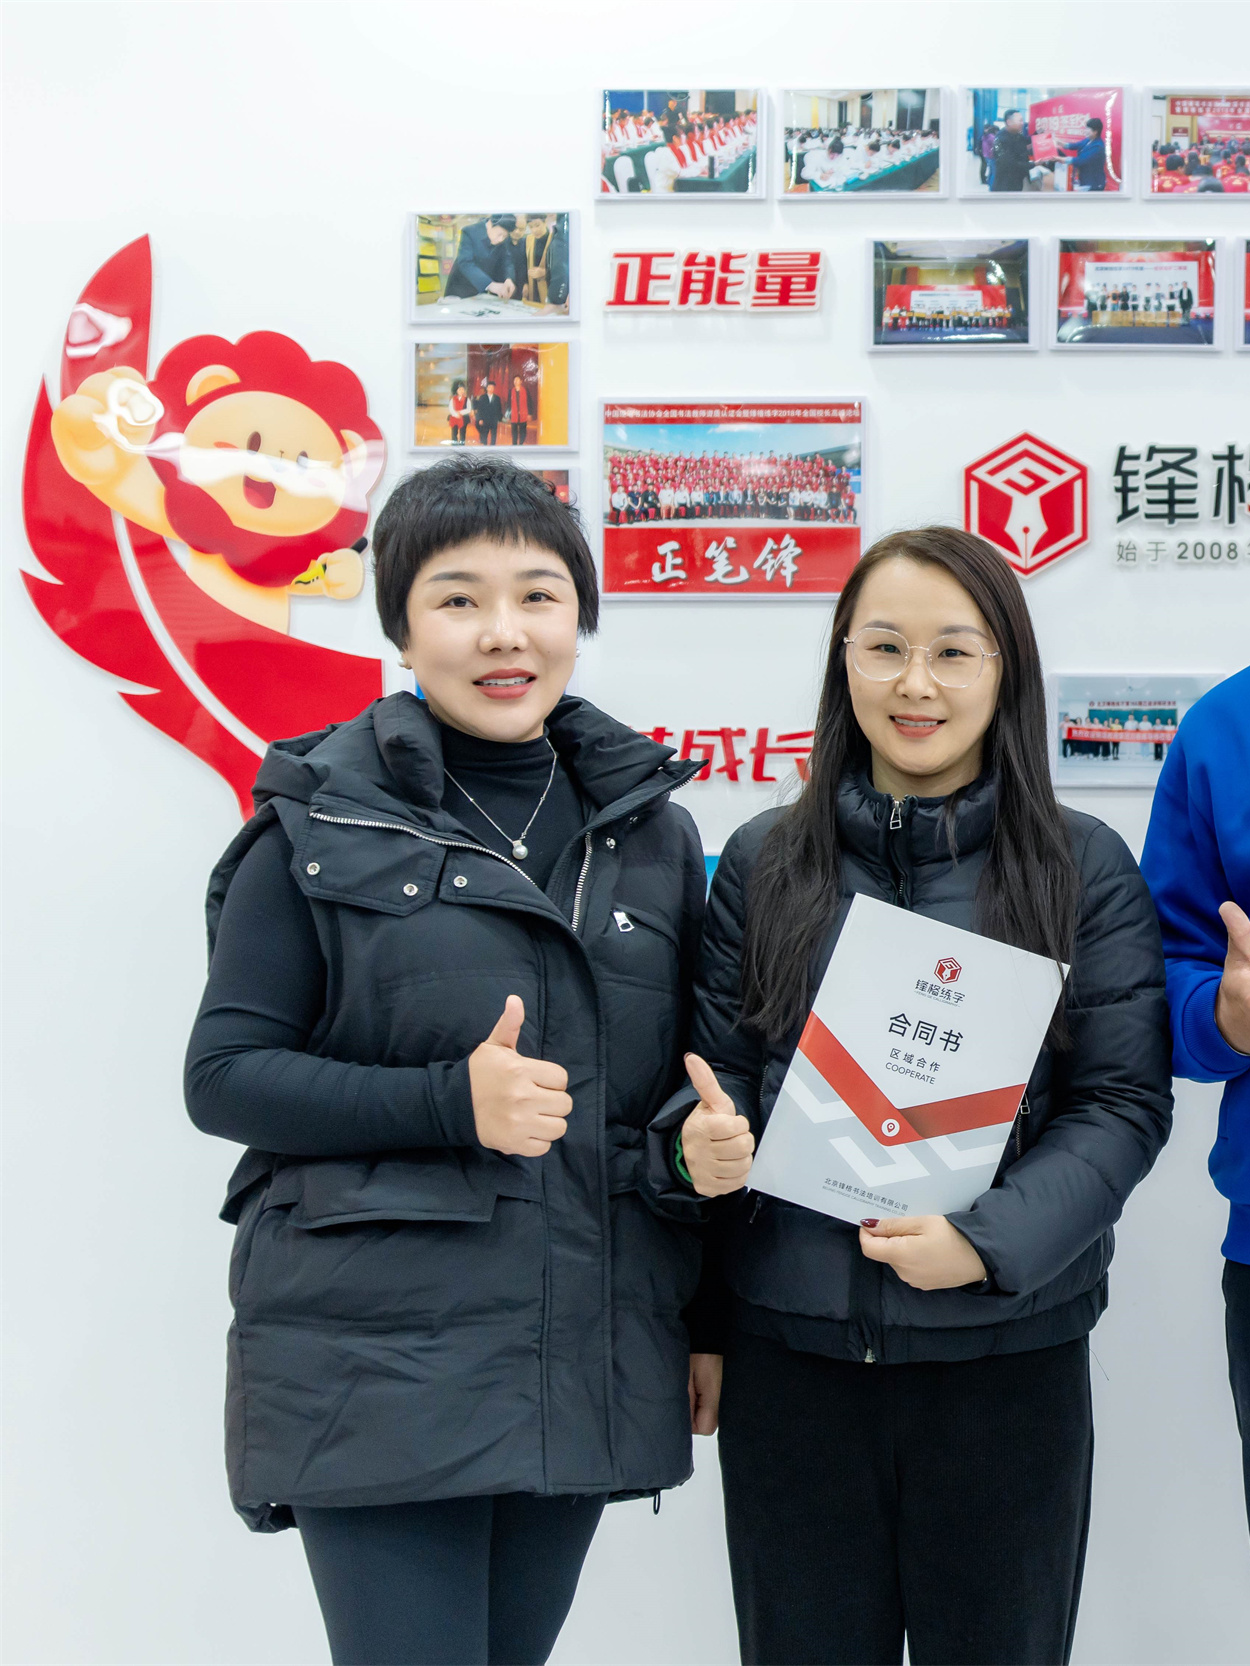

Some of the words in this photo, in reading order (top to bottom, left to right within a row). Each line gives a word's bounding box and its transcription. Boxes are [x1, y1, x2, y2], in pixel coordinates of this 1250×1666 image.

[605, 251, 823, 308] 正能量
[650, 533, 804, 589] 正笔锋
[636, 726, 815, 783] 成长
[915, 979, 966, 1004] 锋格练字
[888, 1013, 964, 1053] 合同书
[885, 1062, 936, 1085] COOPERATE
[889, 1048, 941, 1073] 区域合作
